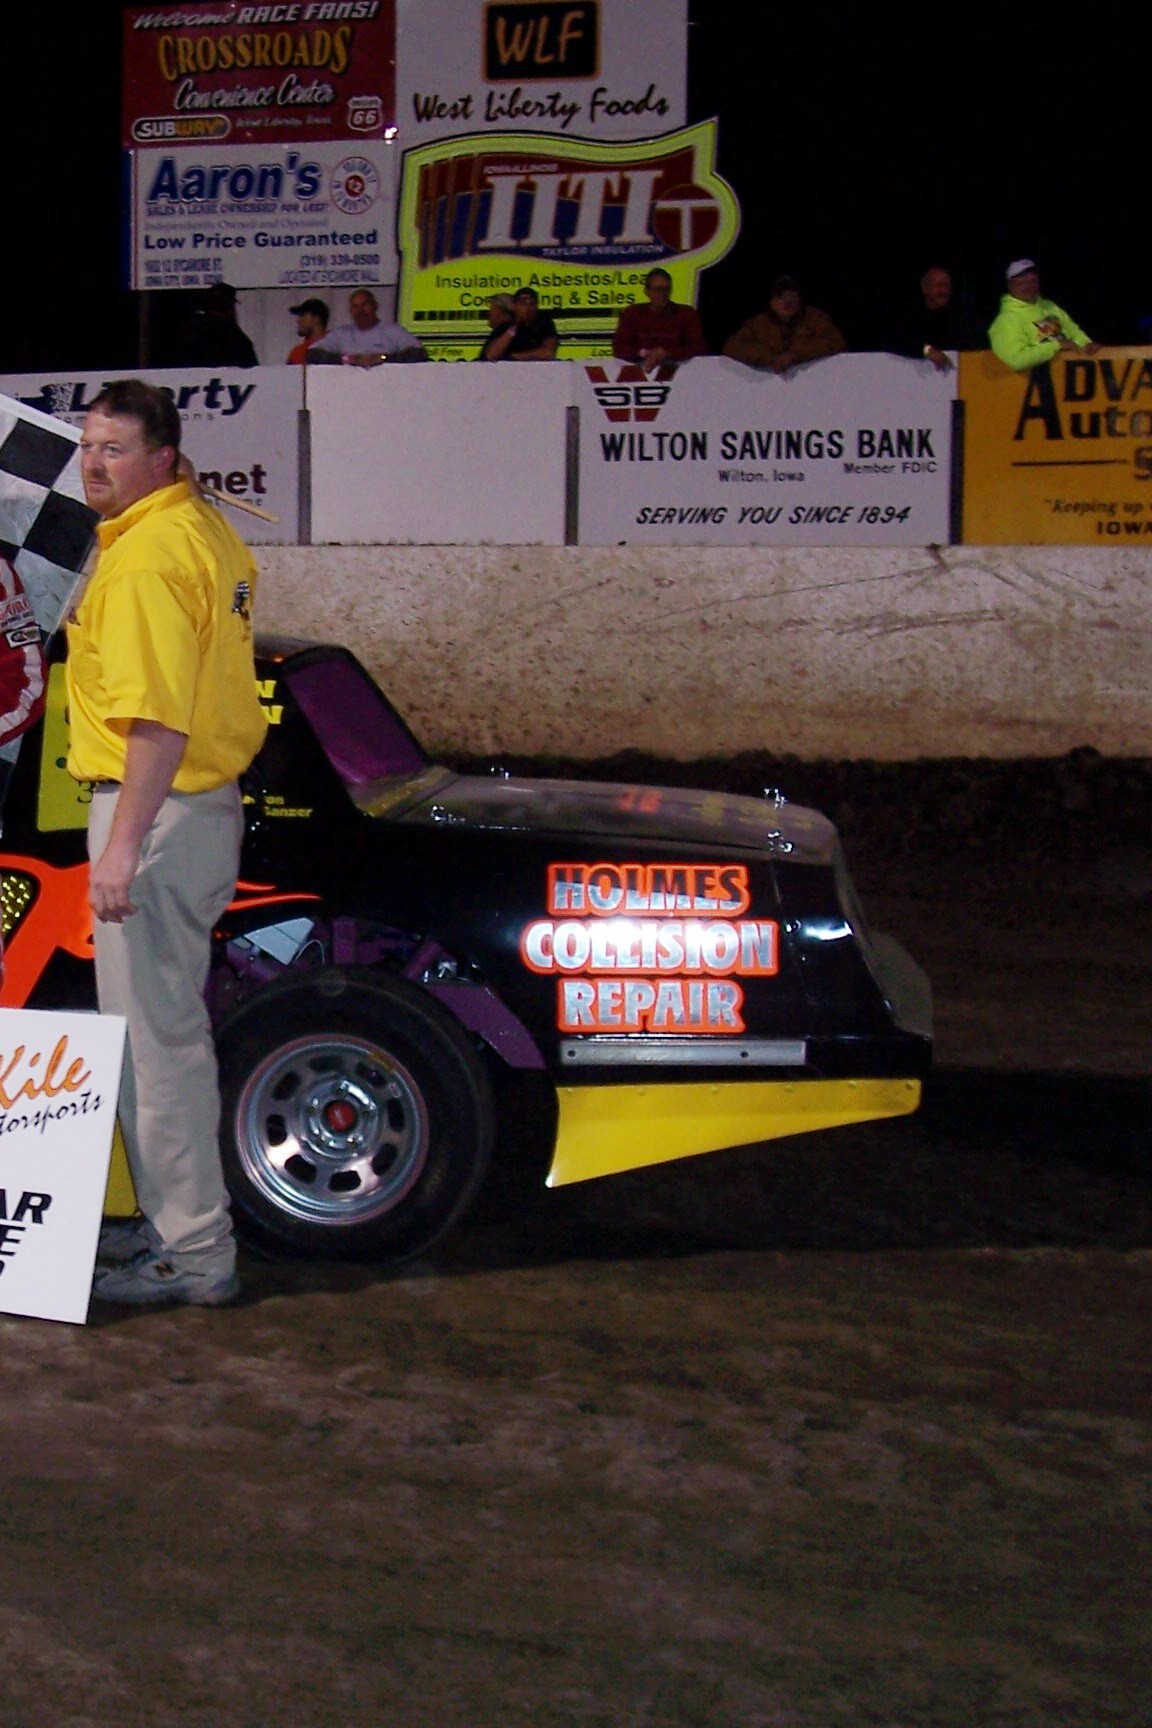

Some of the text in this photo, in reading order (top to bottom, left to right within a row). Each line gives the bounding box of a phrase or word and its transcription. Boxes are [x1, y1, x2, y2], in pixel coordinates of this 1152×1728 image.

[133, 1, 380, 29] Welcome RACE FANS!
[158, 25, 352, 81] CROSSROADS
[497, 10, 585, 65] WLF
[174, 73, 336, 111] Convenience Center
[413, 84, 670, 129] West Liberty Foods
[136, 120, 224, 138] SUBWAY
[351, 110, 375, 125] 66
[149, 152, 322, 203] Aaron's
[145, 229, 378, 249] Low Price Guaranteed
[435, 273, 522, 289] Insulation
[569, 292, 581, 306] &
[587, 291, 636, 305] Sales
[600, 428, 937, 462] WILTON SAVINGS BANK
[772, 468, 805, 482] Iowa
[843, 461, 896, 475] Member
[902, 461, 938, 474] FDIC
[636, 505, 912, 525] SERVING YOU SINCE 1894
[551, 866, 747, 912] HOLMES
[523, 919, 777, 973] COLLISION
[560, 980, 742, 1030] REPAIR
